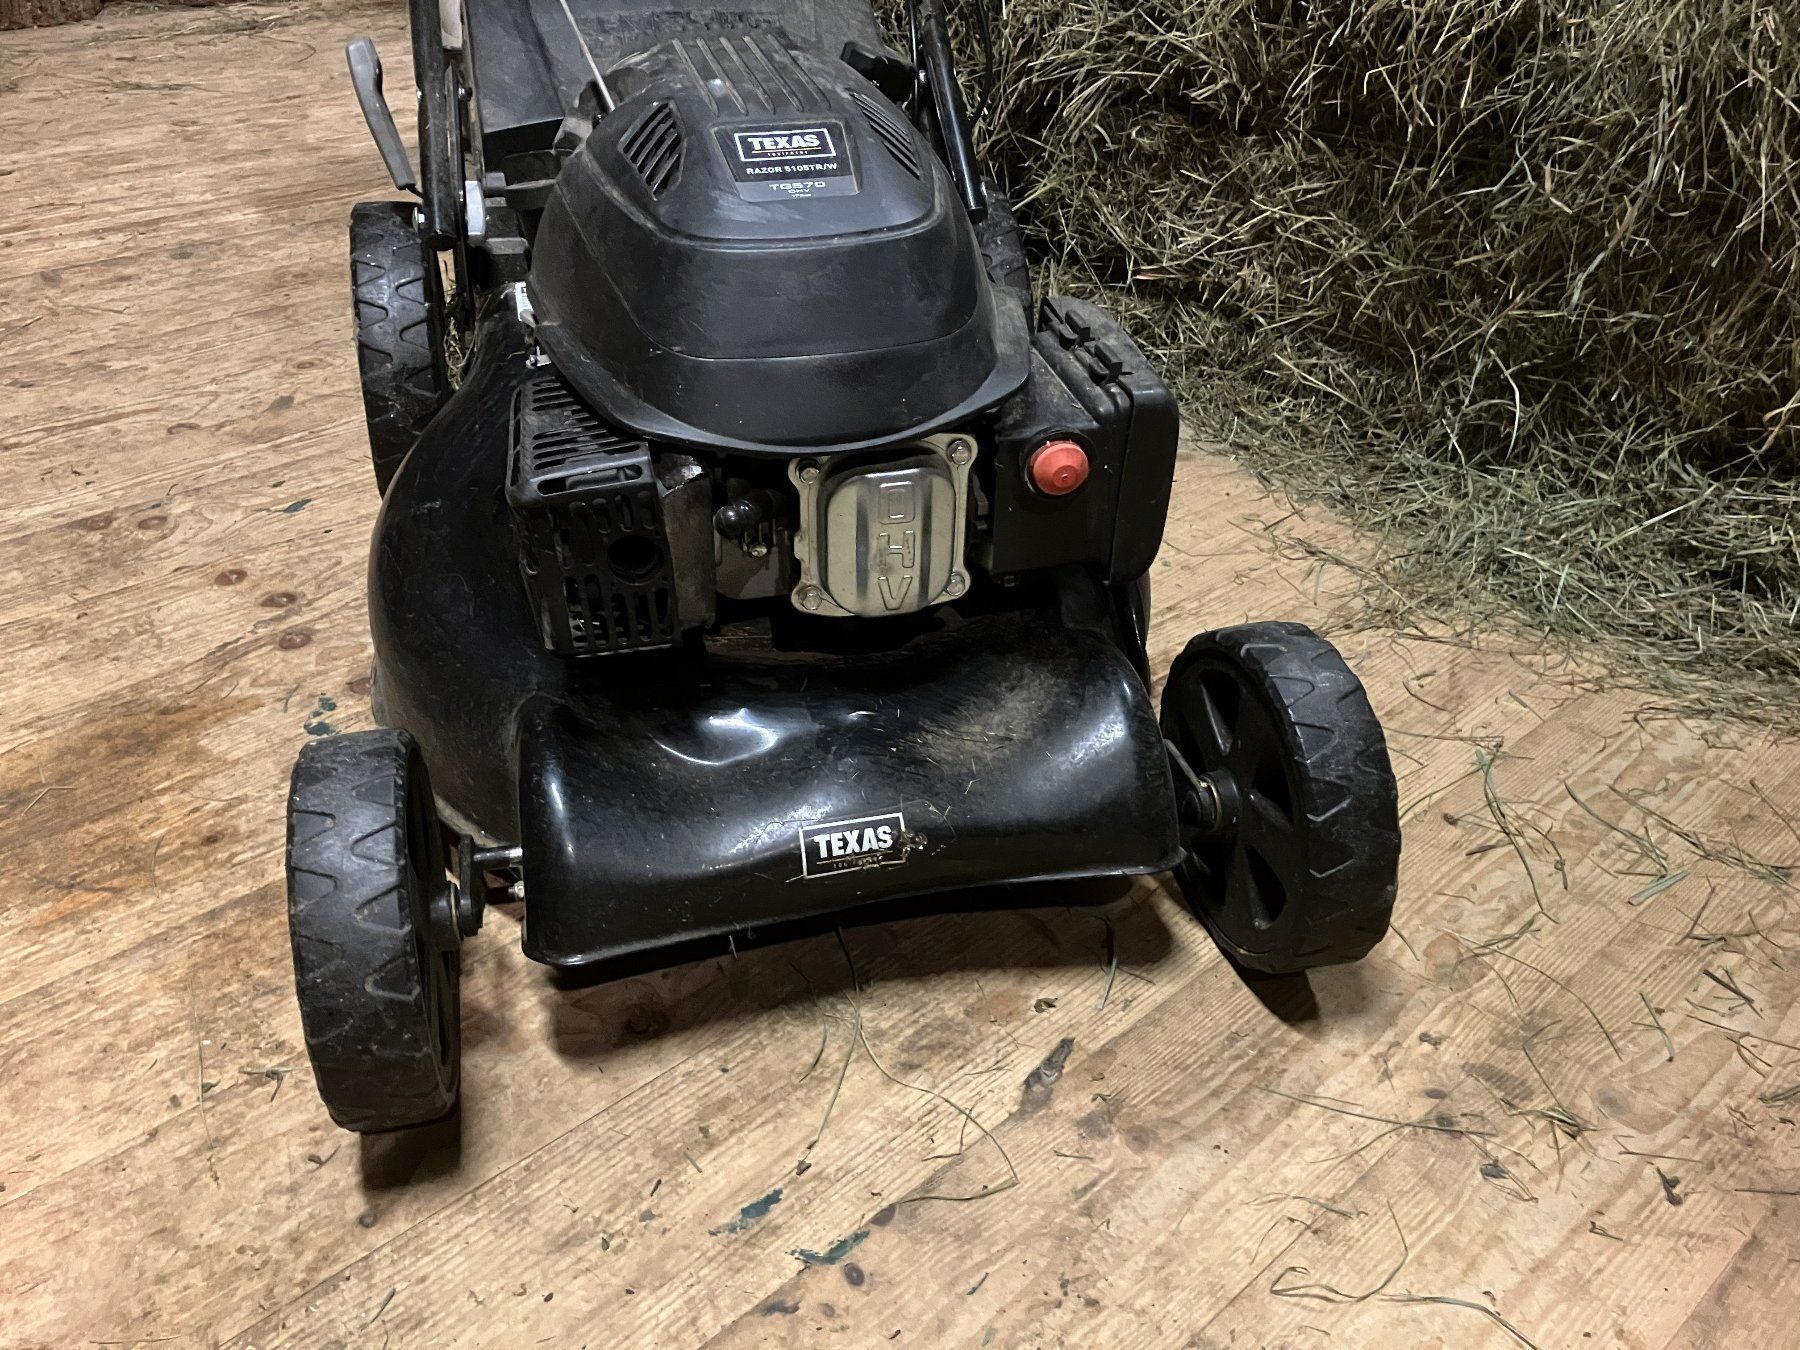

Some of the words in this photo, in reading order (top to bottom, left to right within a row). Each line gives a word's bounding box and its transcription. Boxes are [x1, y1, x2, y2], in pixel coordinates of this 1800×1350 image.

[747, 134, 821, 151] TEXAS
[746, 165, 783, 175] RAZOR
[813, 825, 894, 859] TEXAS
